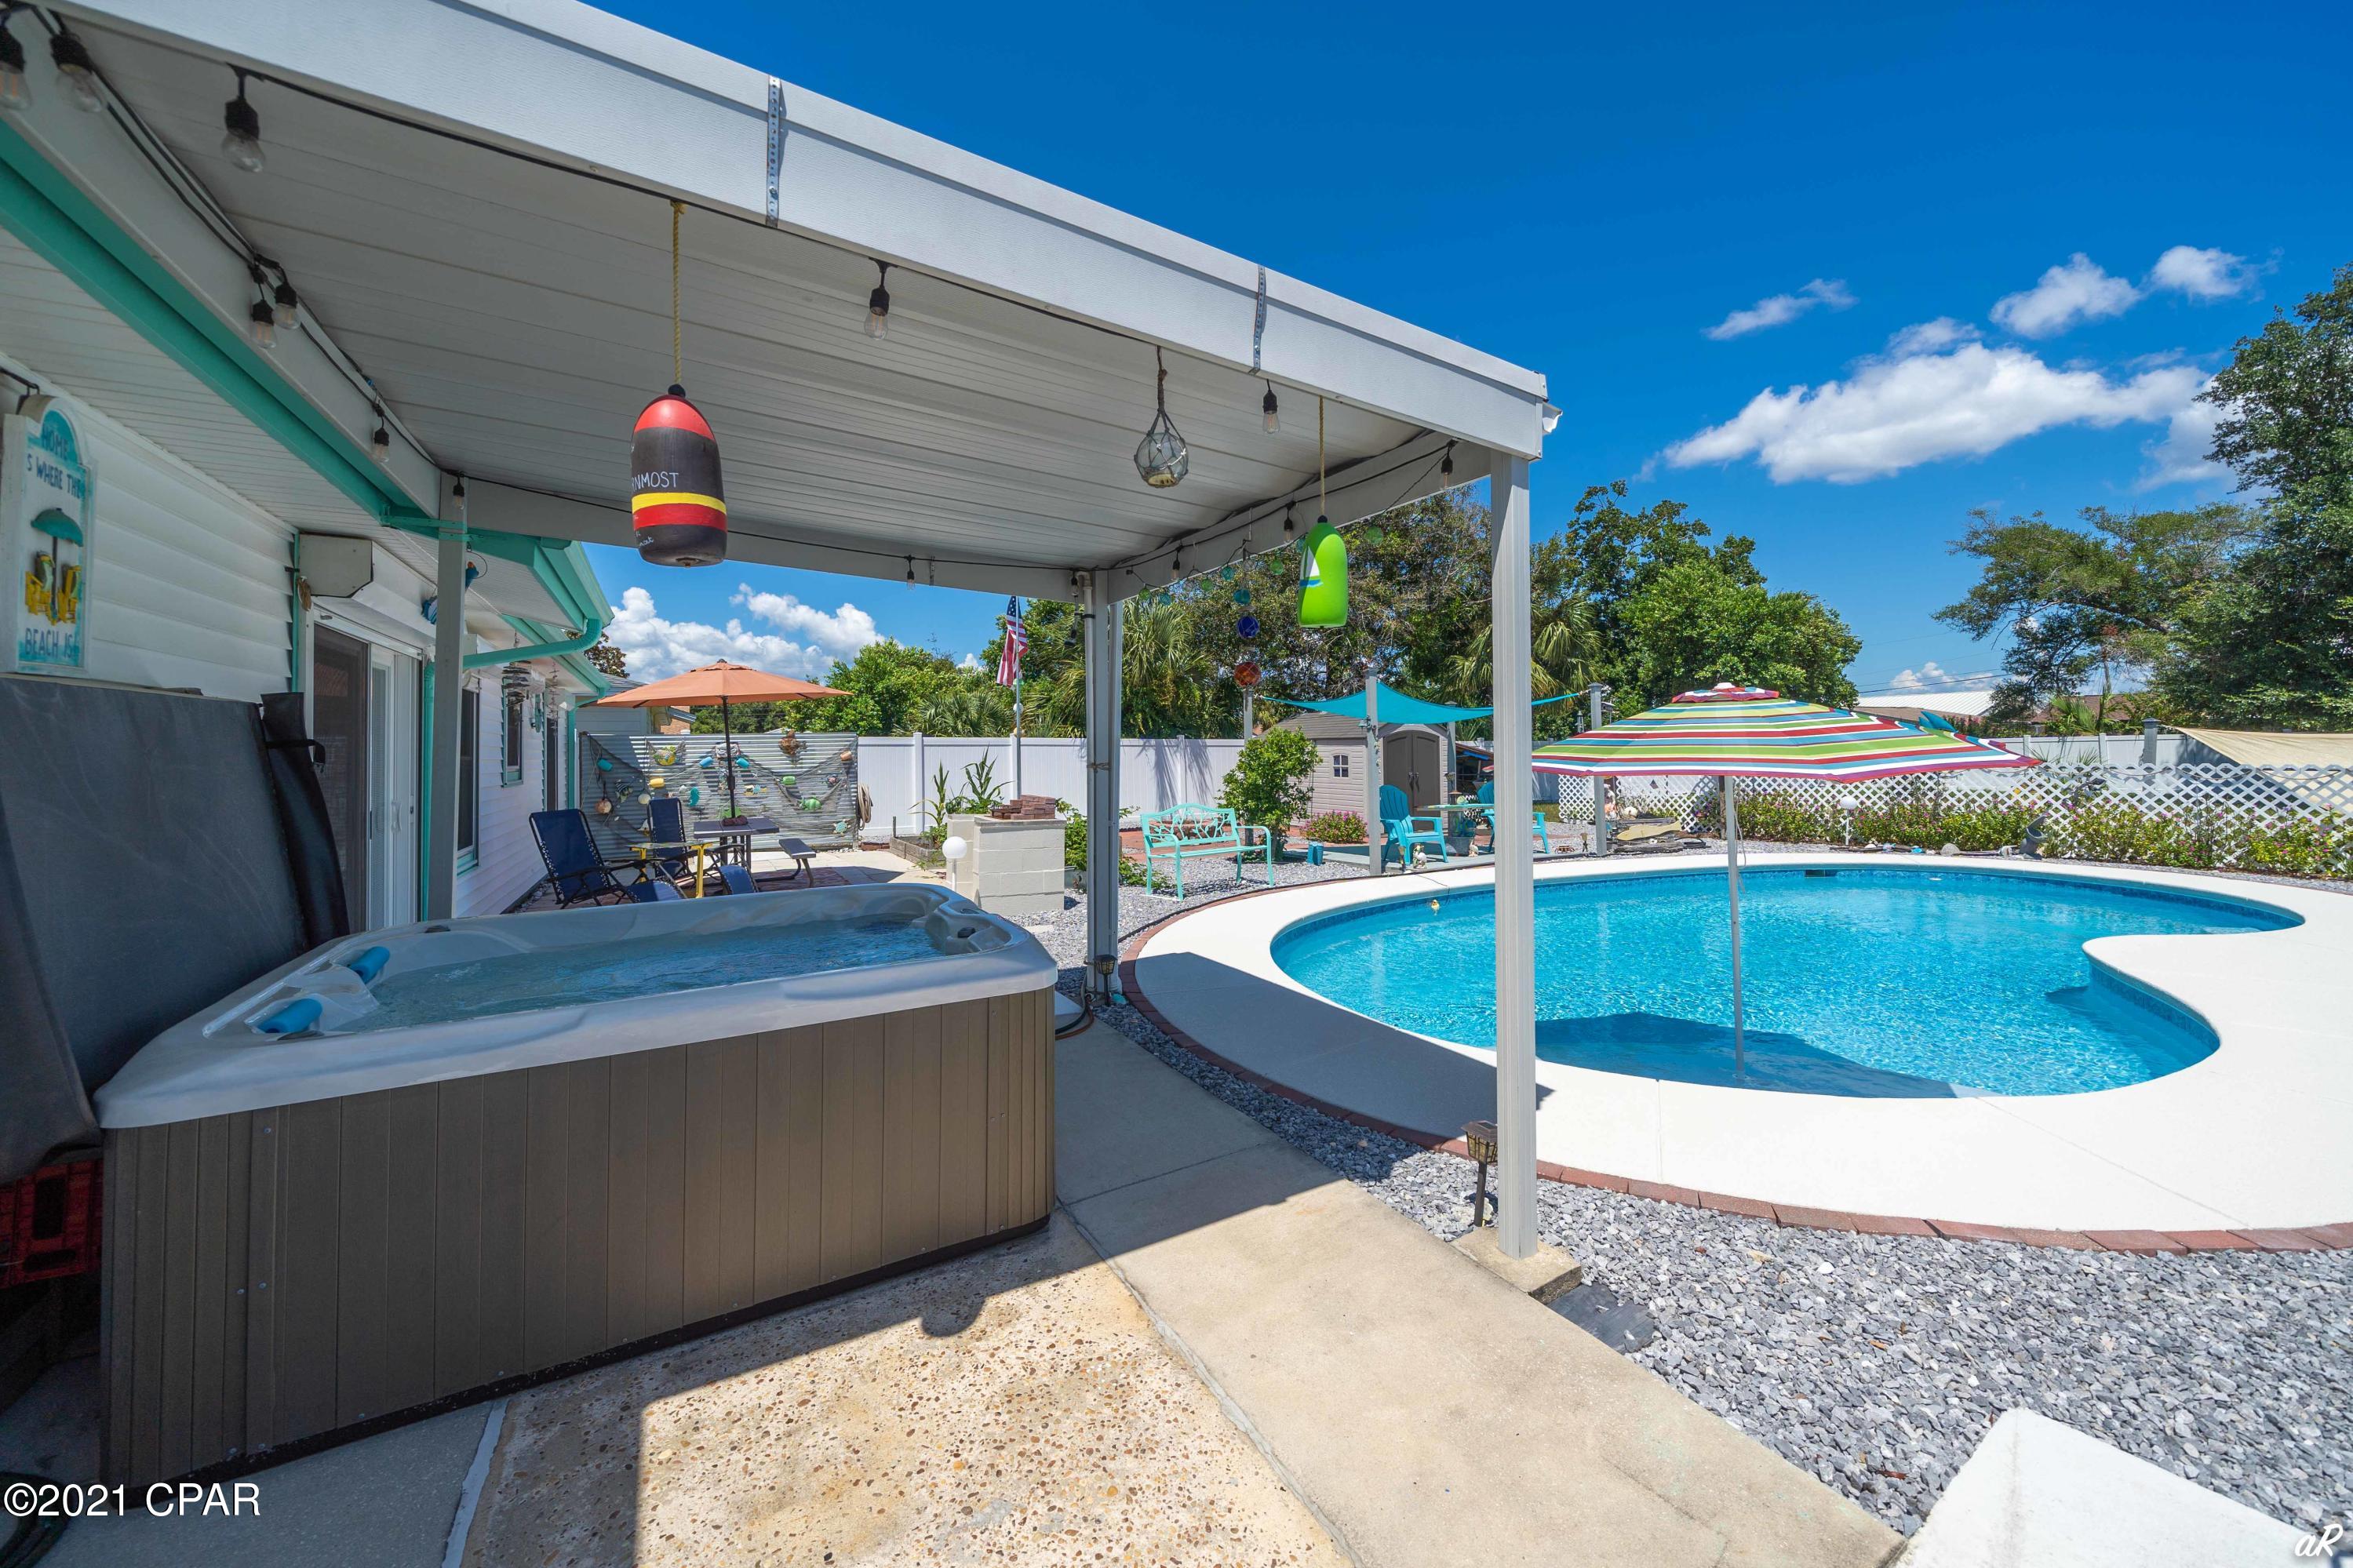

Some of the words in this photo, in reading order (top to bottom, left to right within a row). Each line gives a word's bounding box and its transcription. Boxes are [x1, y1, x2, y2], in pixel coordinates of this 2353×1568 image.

[41, 424, 69, 461] HOME
[36, 456, 64, 490] WHERE
[66, 473, 82, 500] THE
[25, 628, 60, 659] BEACH
